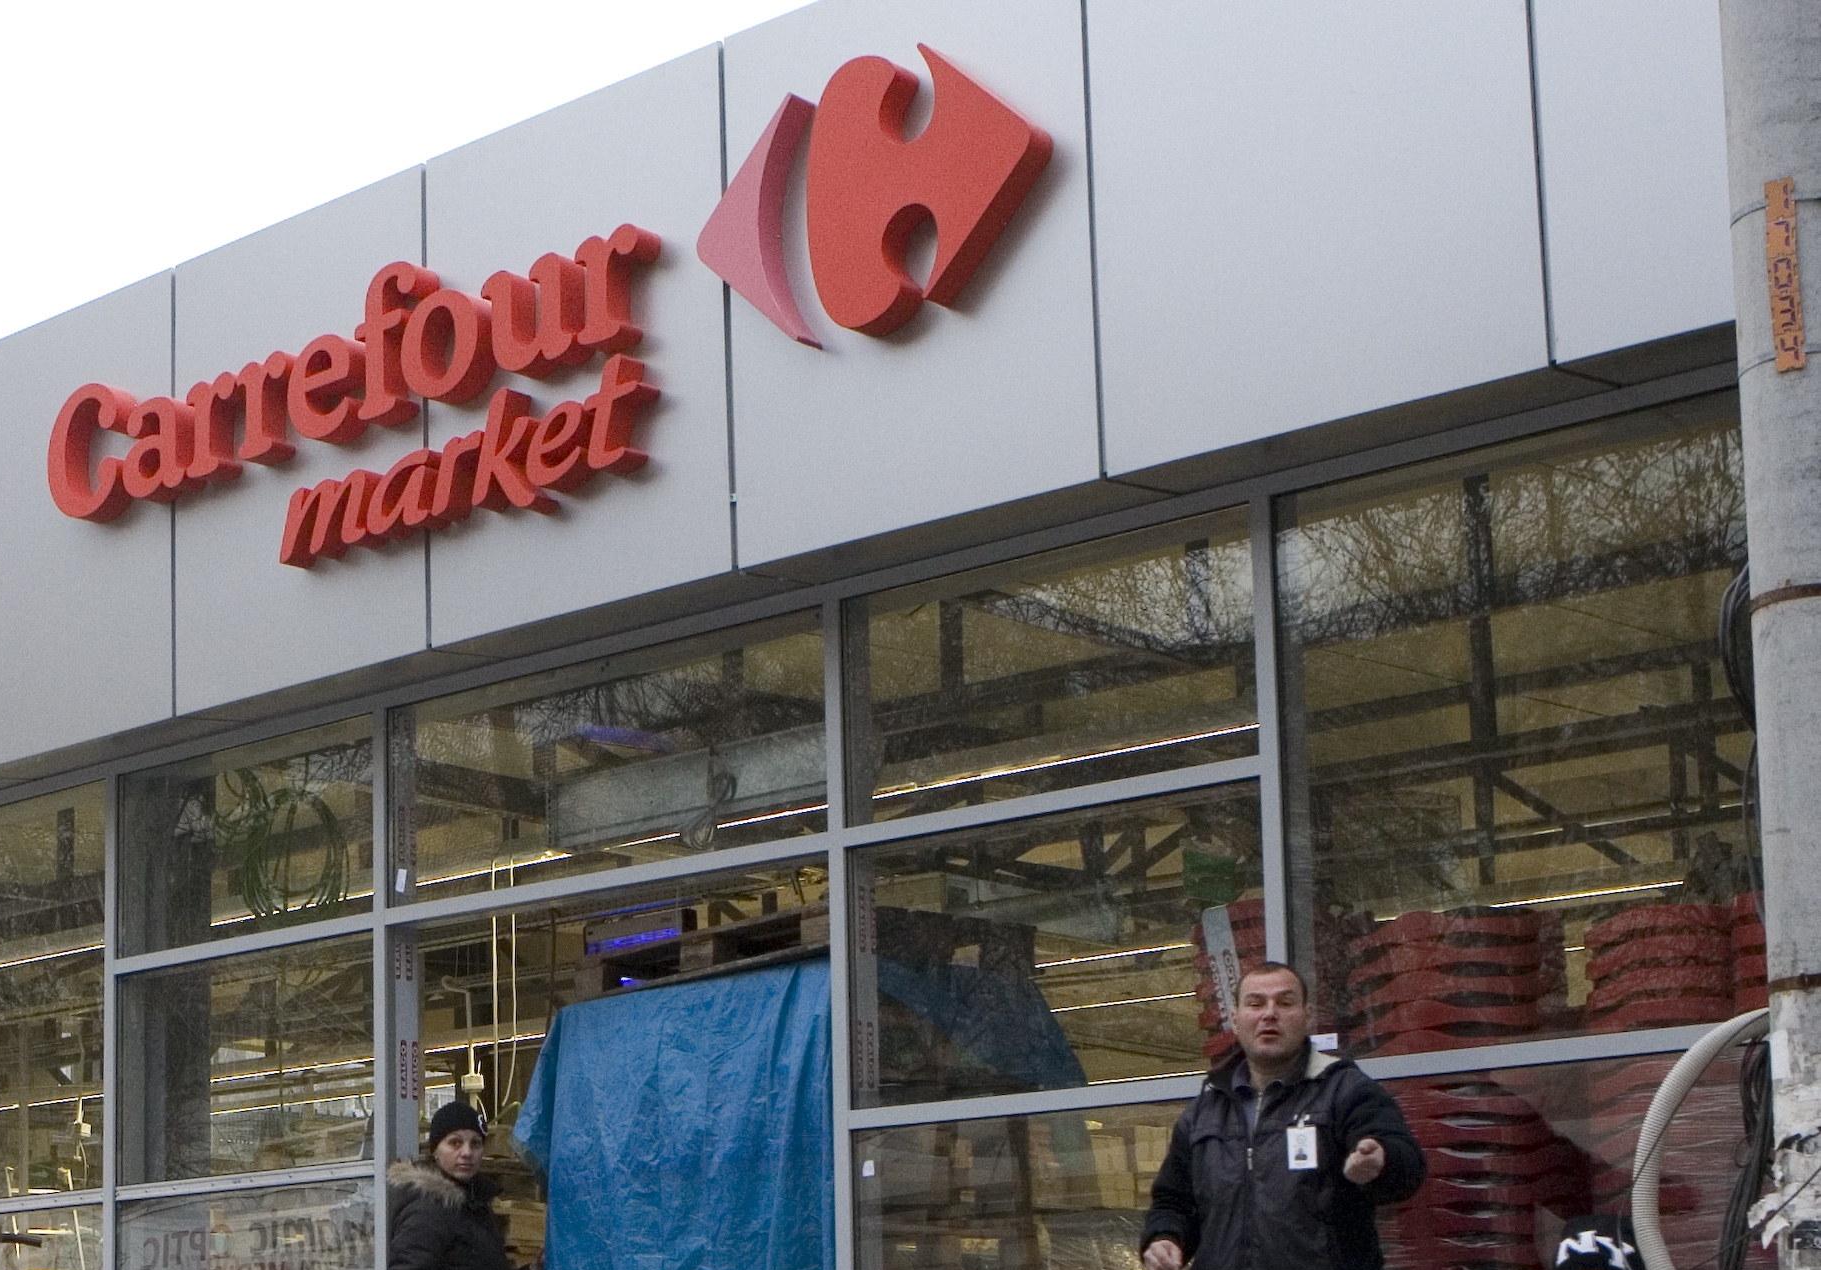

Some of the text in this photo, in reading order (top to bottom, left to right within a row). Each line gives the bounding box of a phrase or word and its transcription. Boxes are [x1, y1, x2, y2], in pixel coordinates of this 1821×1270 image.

[47, 223, 662, 523] Carrefour
[279, 354, 662, 569] market
[1556, 1230, 1635, 1270] NY
